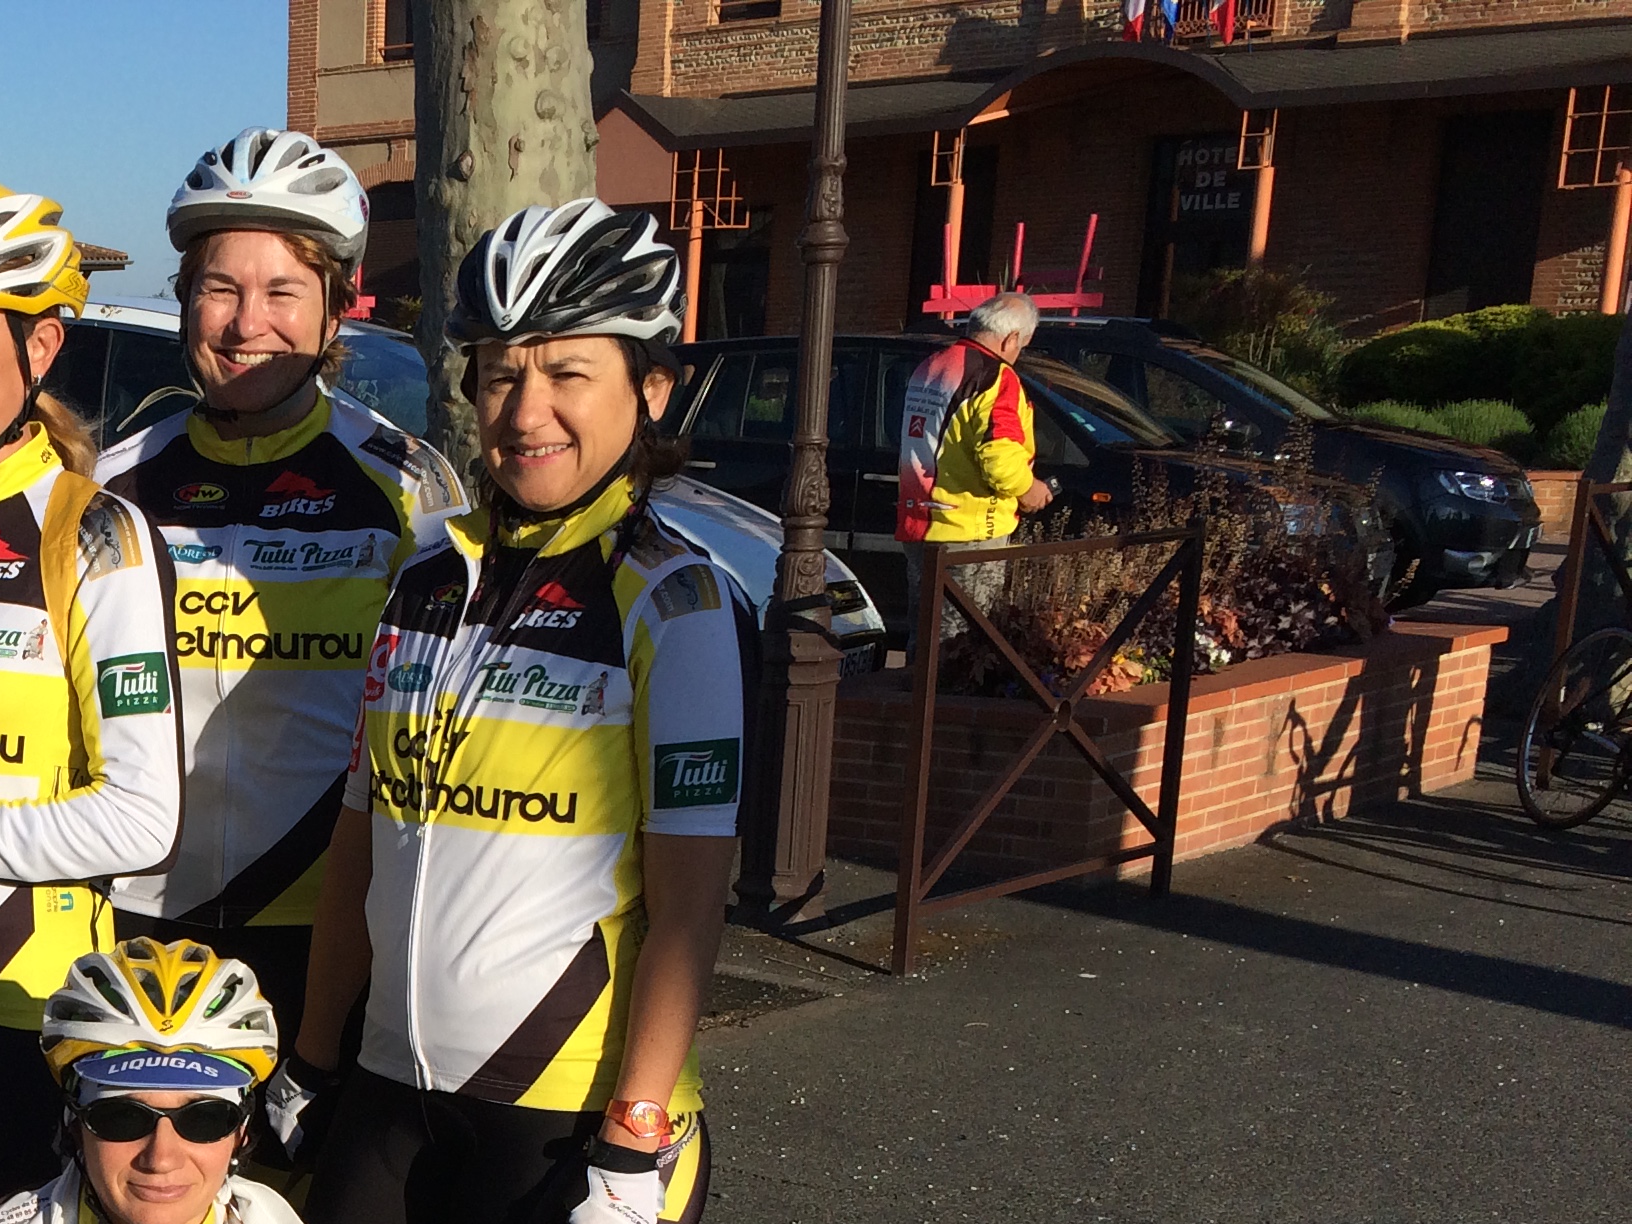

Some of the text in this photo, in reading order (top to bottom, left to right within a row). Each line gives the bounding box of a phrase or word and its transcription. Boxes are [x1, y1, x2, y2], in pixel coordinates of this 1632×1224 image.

[1179, 147, 1250, 166] HOTE
[1195, 171, 1226, 188] DE
[1180, 192, 1241, 211] VILLE
[258, 494, 337, 518] BIKES
[244, 539, 354, 566] Tutti Pizza
[101, 661, 159, 698] Tutti
[522, 664, 583, 702] Pizza
[116, 697, 159, 708] PIZZA
[658, 750, 729, 787] Tutti
[673, 787, 724, 799] PIZZA
[107, 1055, 220, 1078] LIQUIGAS
